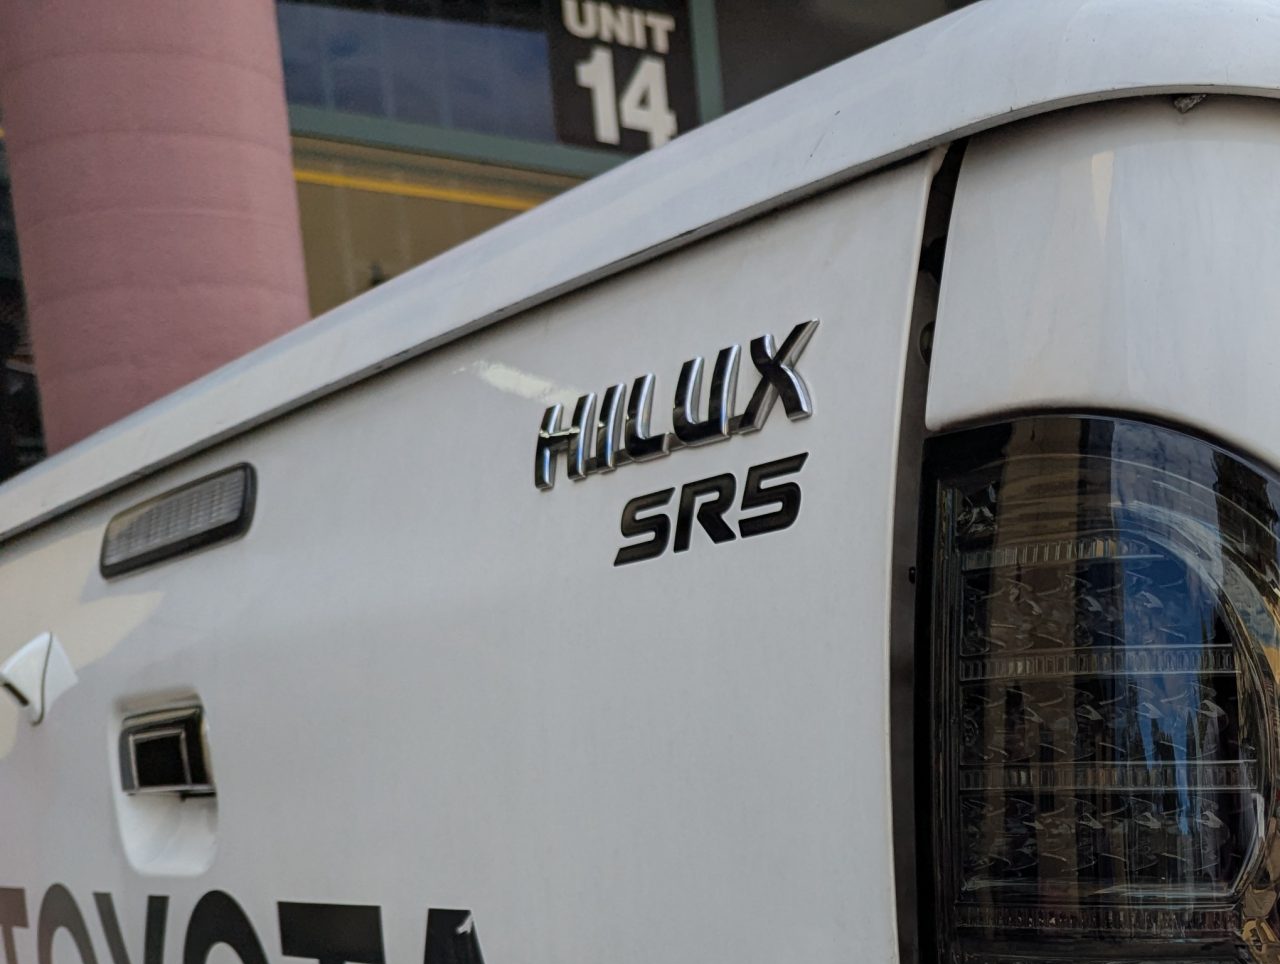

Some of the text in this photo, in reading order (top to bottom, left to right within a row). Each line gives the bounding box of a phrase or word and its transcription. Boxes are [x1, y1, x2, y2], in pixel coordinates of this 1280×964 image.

[561, 0, 676, 55] UNIT
[575, 44, 677, 148] 14
[534, 317, 820, 492] HILUX
[613, 452, 809, 567] SR5
